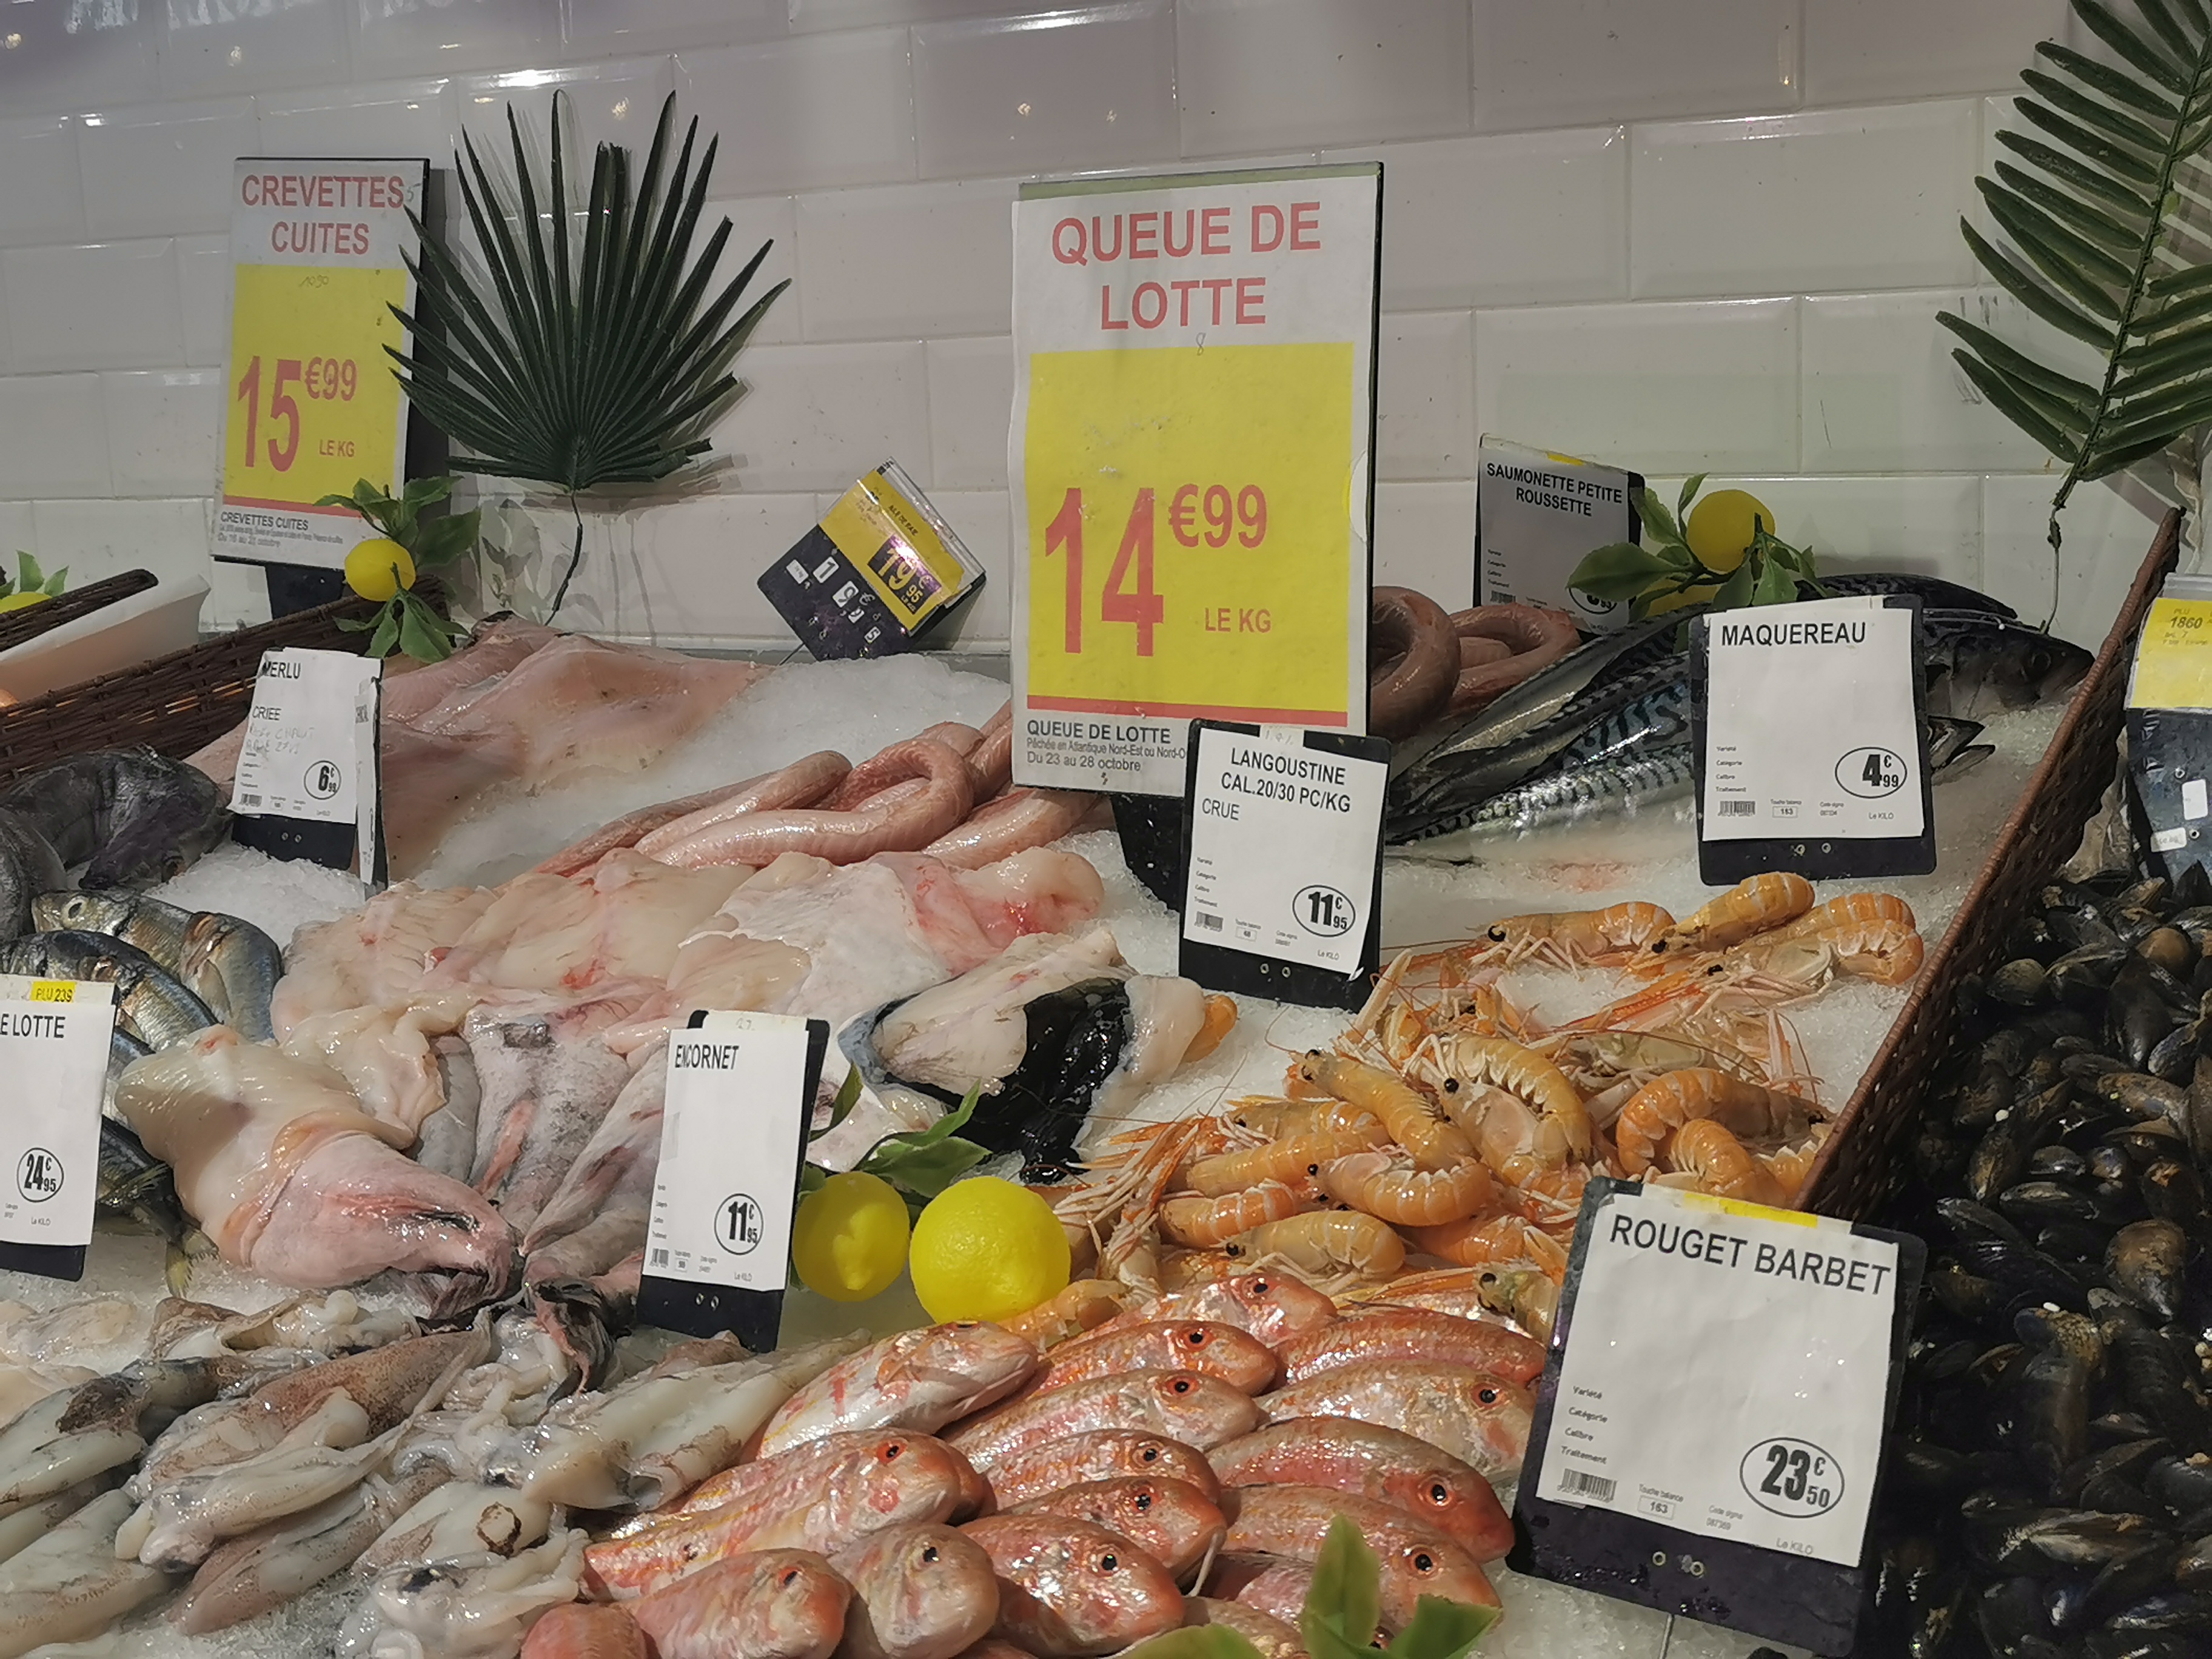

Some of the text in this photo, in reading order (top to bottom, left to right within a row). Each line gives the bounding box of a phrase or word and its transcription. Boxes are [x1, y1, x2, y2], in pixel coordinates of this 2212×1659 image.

[243, 174, 404, 208] CREVETTES
[272, 221, 369, 255] CUITES
[1052, 201, 1321, 266] QUEUE DE
[1101, 277, 1265, 330] LOTTE
[319, 440, 355, 457] LE KG
[1487, 463, 1623, 503] SAUMONETTE PETITE
[1517, 487, 1592, 517] ROUSSETTE
[221, 511, 308, 531] CREVETTES CUITES
[1205, 608, 1272, 633] LE KG
[2171, 616, 2203, 629] 1860
[1721, 622, 1866, 646] MAQUEREAU
[252, 706, 281, 720] CRIEE
[1027, 720, 1171, 744] QUEUE DE LOTTE
[1027, 751, 1141, 771] Du 23 au 28 octobre
[1068, 740, 1107, 755] Atlantique
[1108, 743, 1143, 757] Nord-Est
[1145, 749, 1154, 757] ou
[1157, 746, 1186, 759] Nord-O
[1231, 748, 1346, 785] LANGOUSTINE
[1221, 772, 1351, 813] CAL.20/30 PC/KG
[1202, 799, 1239, 820] CRUE
[36, 988, 53, 1001] PLU
[0, 1013, 65, 1038] E LOTTE
[1609, 1214, 1891, 1295] ROUGET BARBET
[1651, 1501, 1667, 1513] 163
[1789, 1541, 1813, 1555] KILO
